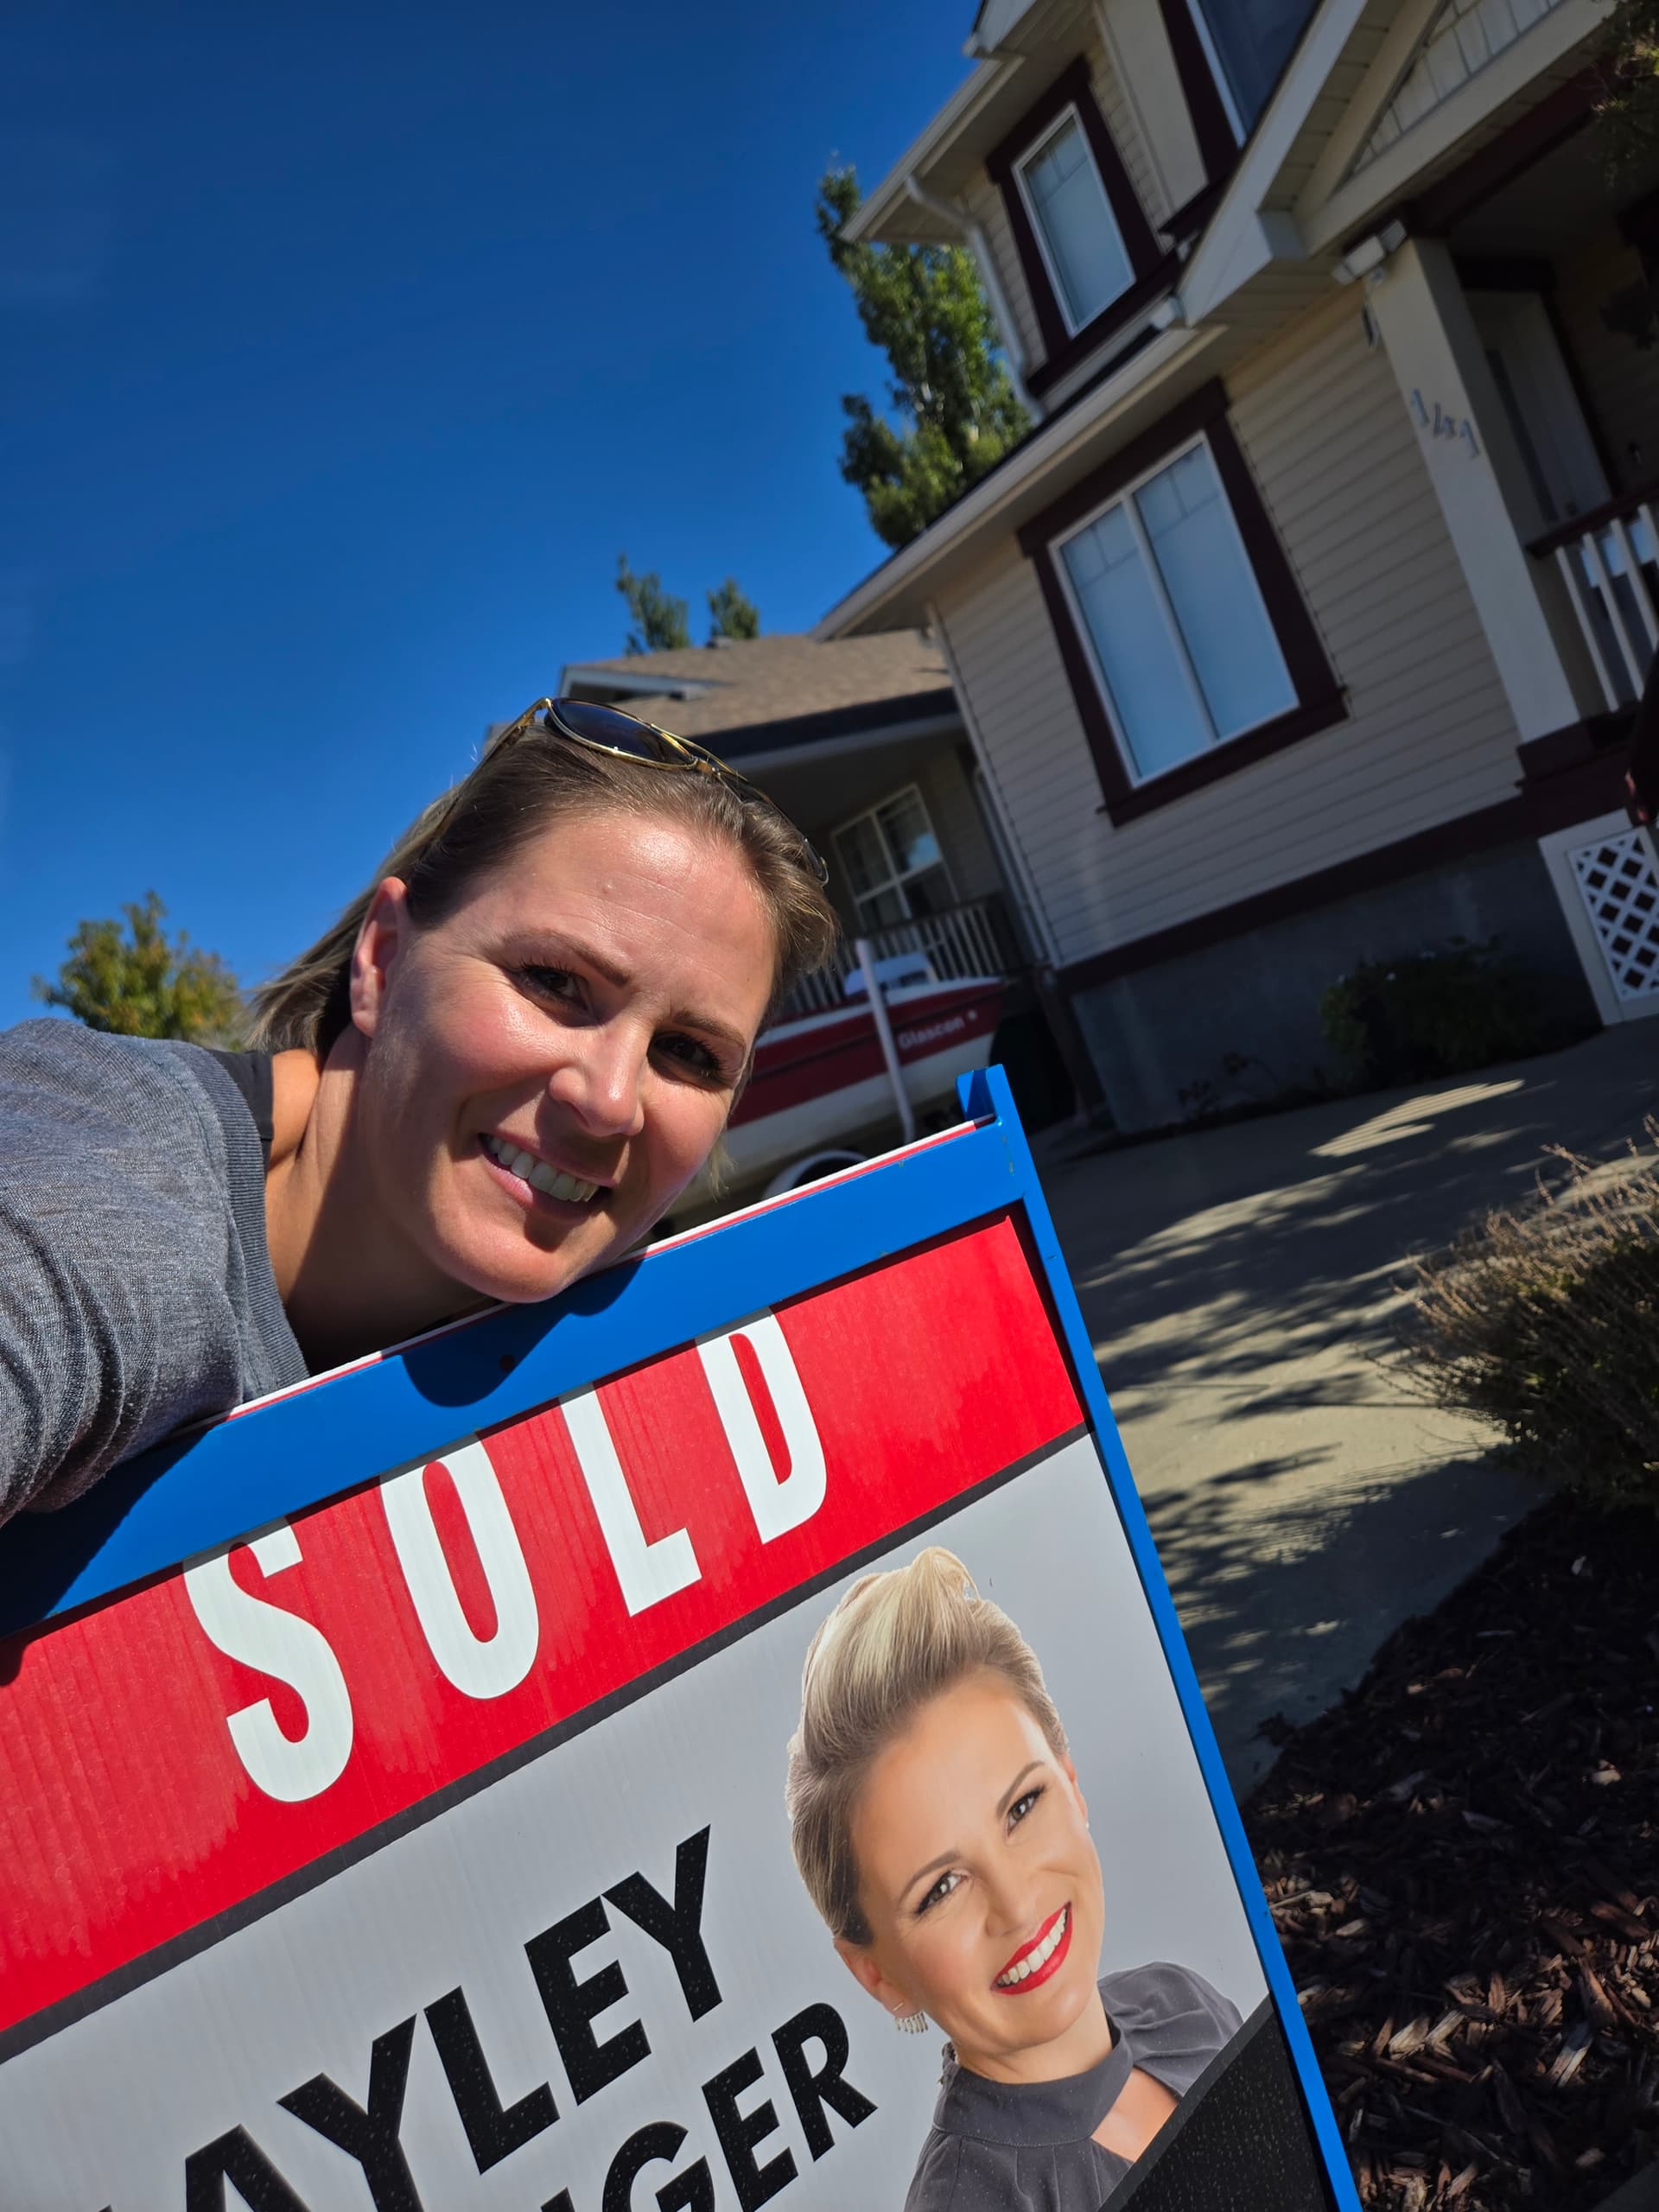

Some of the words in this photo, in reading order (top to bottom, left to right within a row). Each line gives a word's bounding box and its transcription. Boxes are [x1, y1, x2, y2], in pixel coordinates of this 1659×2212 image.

[182, 1307, 827, 1802] SOLD
[99, 1824, 722, 2212] AYLEY
[541, 2003, 878, 2212] GER
